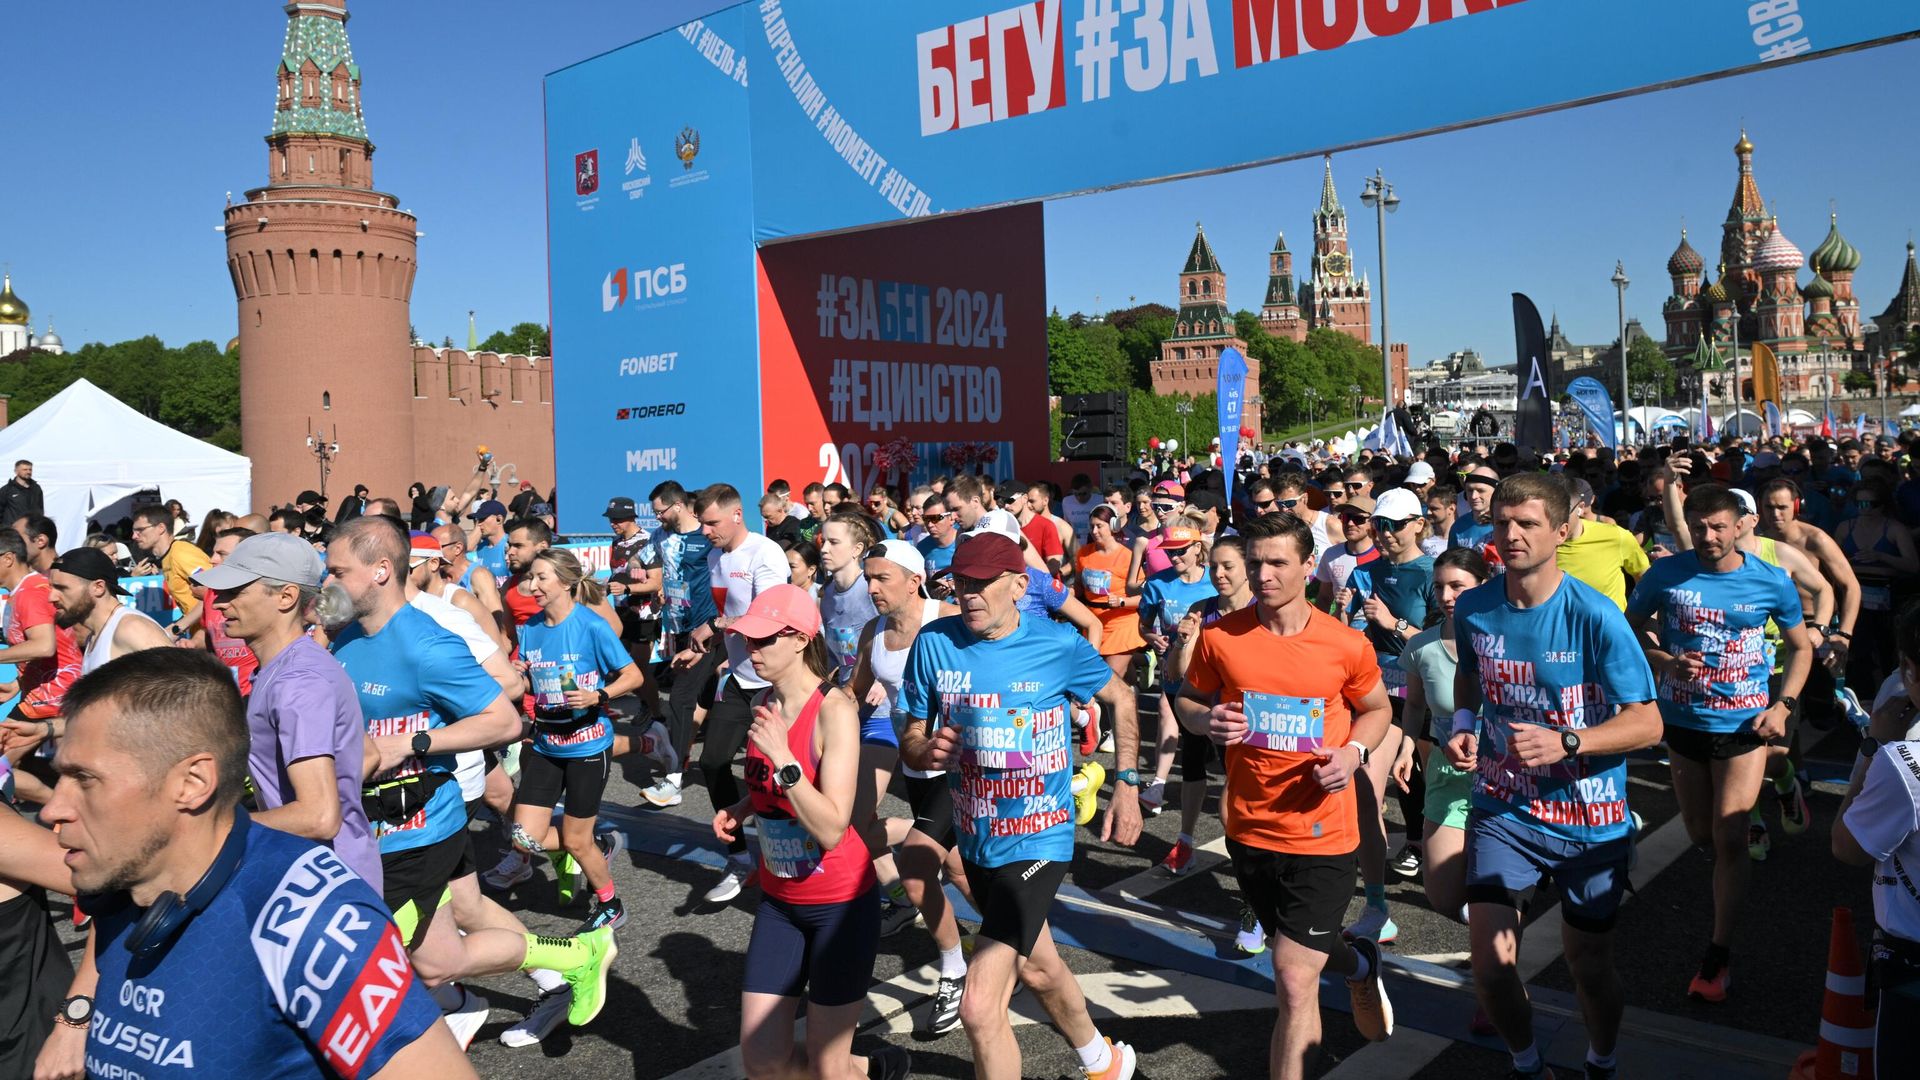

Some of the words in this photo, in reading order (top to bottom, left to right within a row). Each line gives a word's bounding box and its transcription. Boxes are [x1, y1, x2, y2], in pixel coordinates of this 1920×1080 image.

[677, 18, 704, 45] ЕНТ
[697, 27, 736, 76] #ЦЕЛЬ
[916, 0, 1061, 137] БЕГУ
[1074, 0, 1219, 103] #ЗА
[760, 0, 827, 121] #АДРЕНАЛИН
[816, 105, 888, 187] #МОМЕНТ
[877, 167, 932, 218] #ЦЕЛЬ
[634, 263, 687, 300] ПСБ
[817, 273, 931, 343] #ЗАБЕГ
[936, 287, 1007, 349] 2024
[619, 352, 678, 376] FONBET
[829, 359, 1002, 431] #ЕДИНСТВО
[631, 403, 686, 419] TORERO
[626, 448, 677, 472] МАТЧ!
[1669, 589, 1702, 606] 2024
[1676, 604, 1725, 624] #МЕЧТА
[1471, 632, 1506, 658] 2024
[936, 670, 971, 693] 2024
[966, 727, 1015, 749] 31862
[1260, 711, 1307, 735] 31673
[961, 775, 1045, 799] #ГОРДОСТЬ
[259, 851, 349, 948] RUS
[289, 903, 372, 1029] OCR
[119, 979, 165, 1018] OCR
[323, 933, 410, 1067] EAM
[91, 1009, 194, 1069] RUSSIA
[86, 1054, 148, 1080] AMPIO
